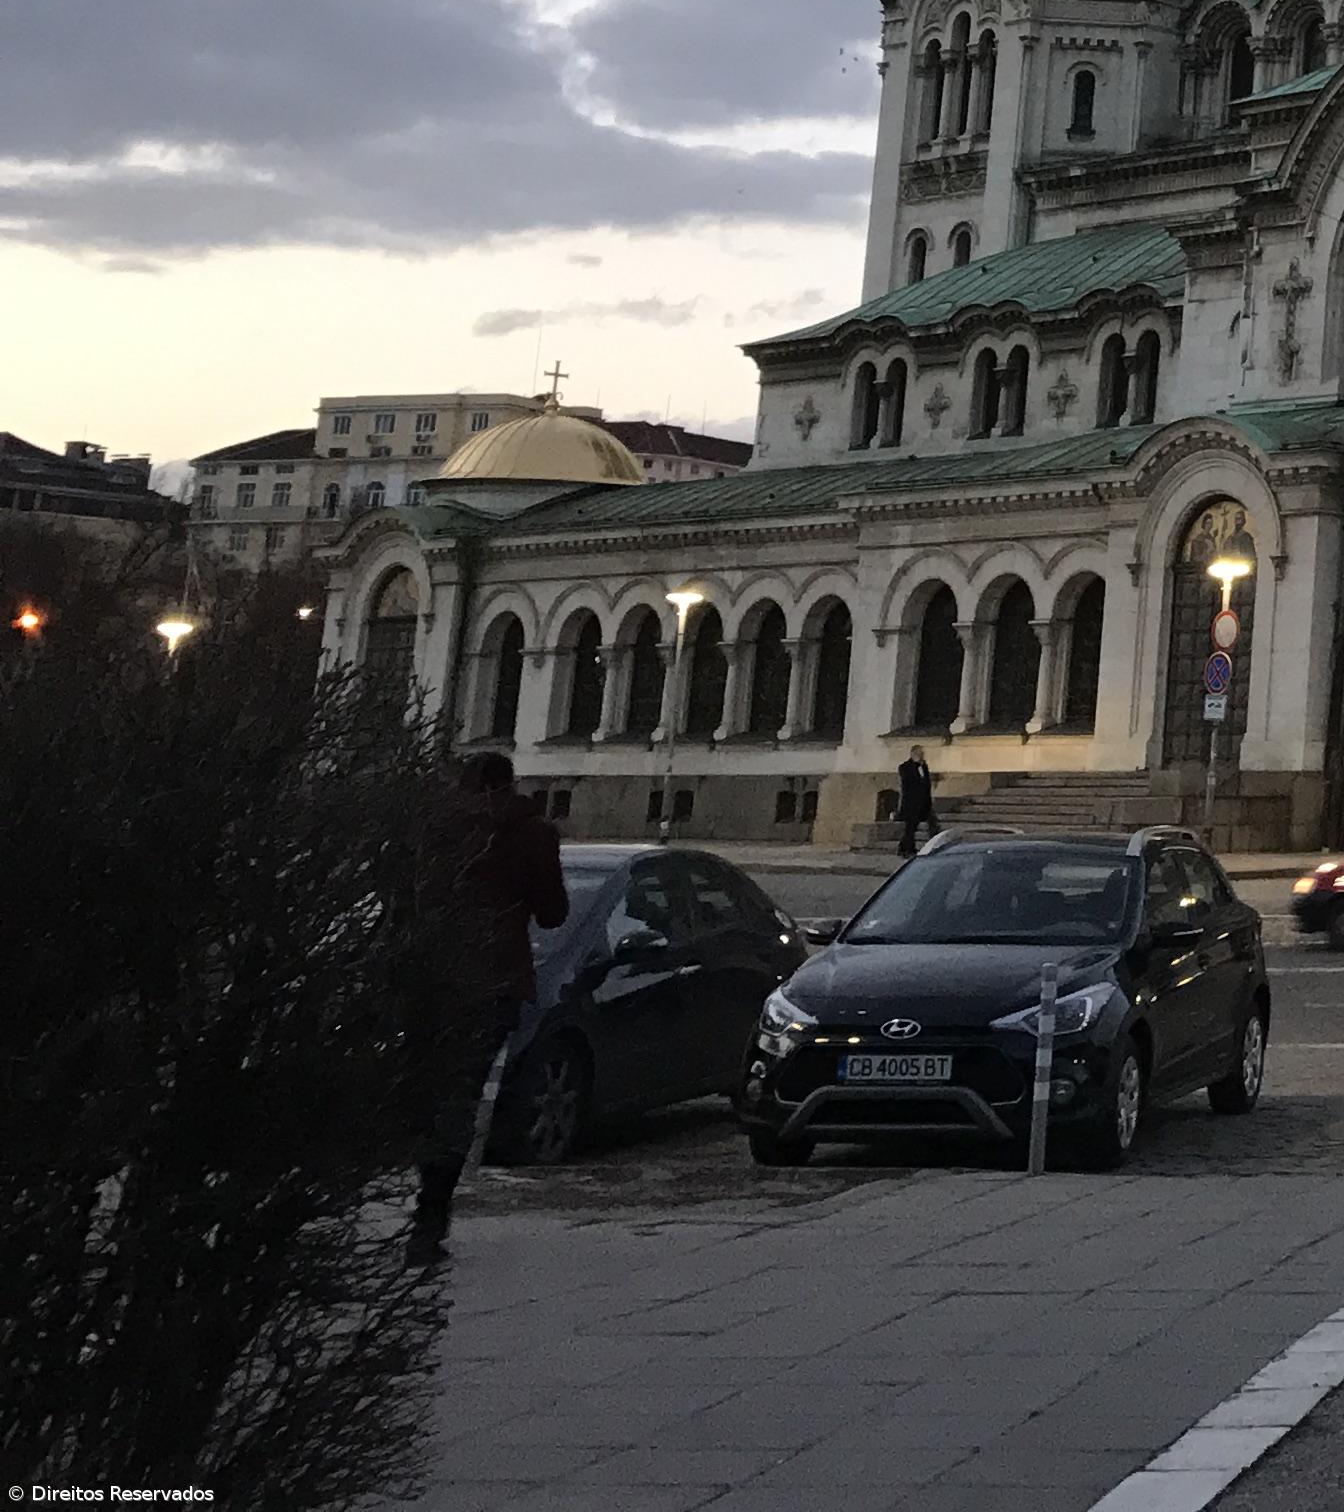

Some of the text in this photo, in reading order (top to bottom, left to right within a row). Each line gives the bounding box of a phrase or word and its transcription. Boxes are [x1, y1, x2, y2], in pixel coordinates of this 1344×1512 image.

[849, 1057, 949, 1077] CB 4005 BT
